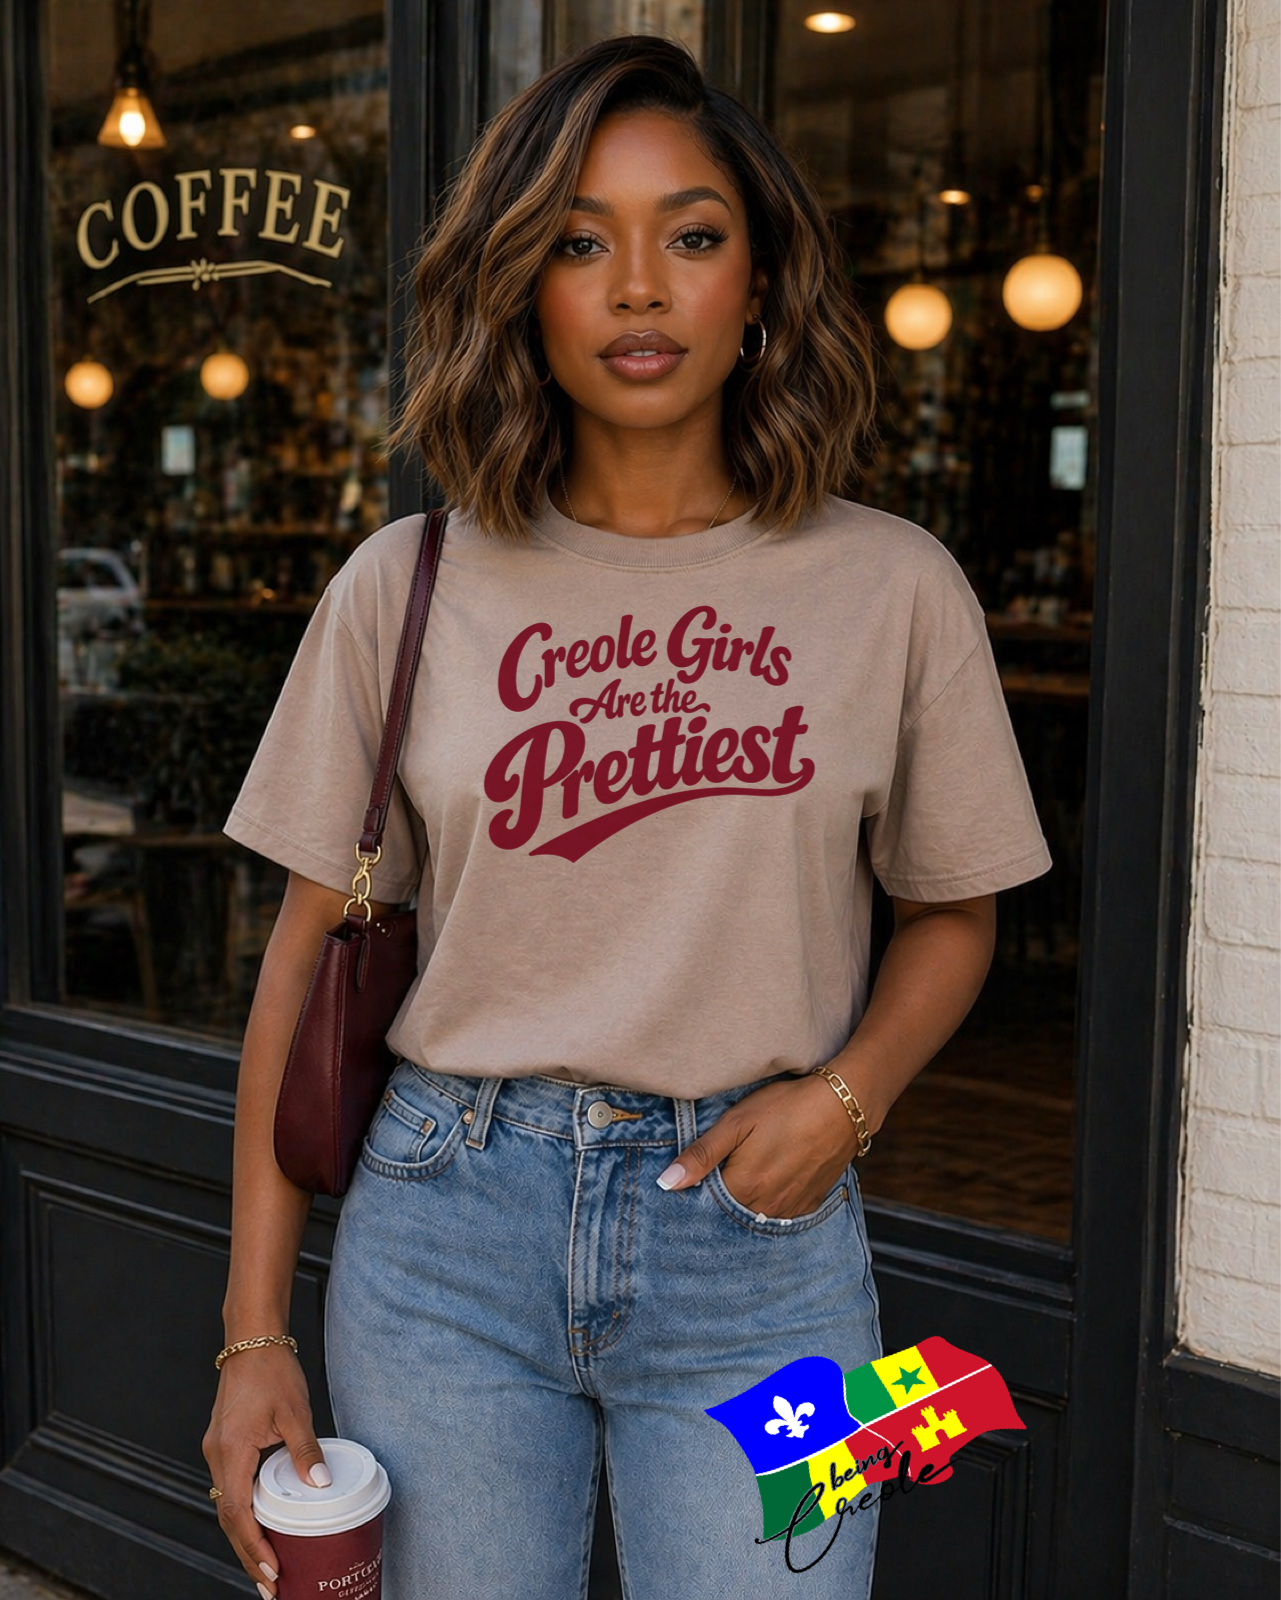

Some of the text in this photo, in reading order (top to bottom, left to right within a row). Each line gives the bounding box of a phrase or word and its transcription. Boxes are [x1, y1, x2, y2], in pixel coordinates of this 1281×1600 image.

[77, 168, 351, 270] COFFEE
[498, 605, 792, 712] Creole Girls
[569, 678, 711, 724] Are the
[484, 705, 815, 851] Prettiest
